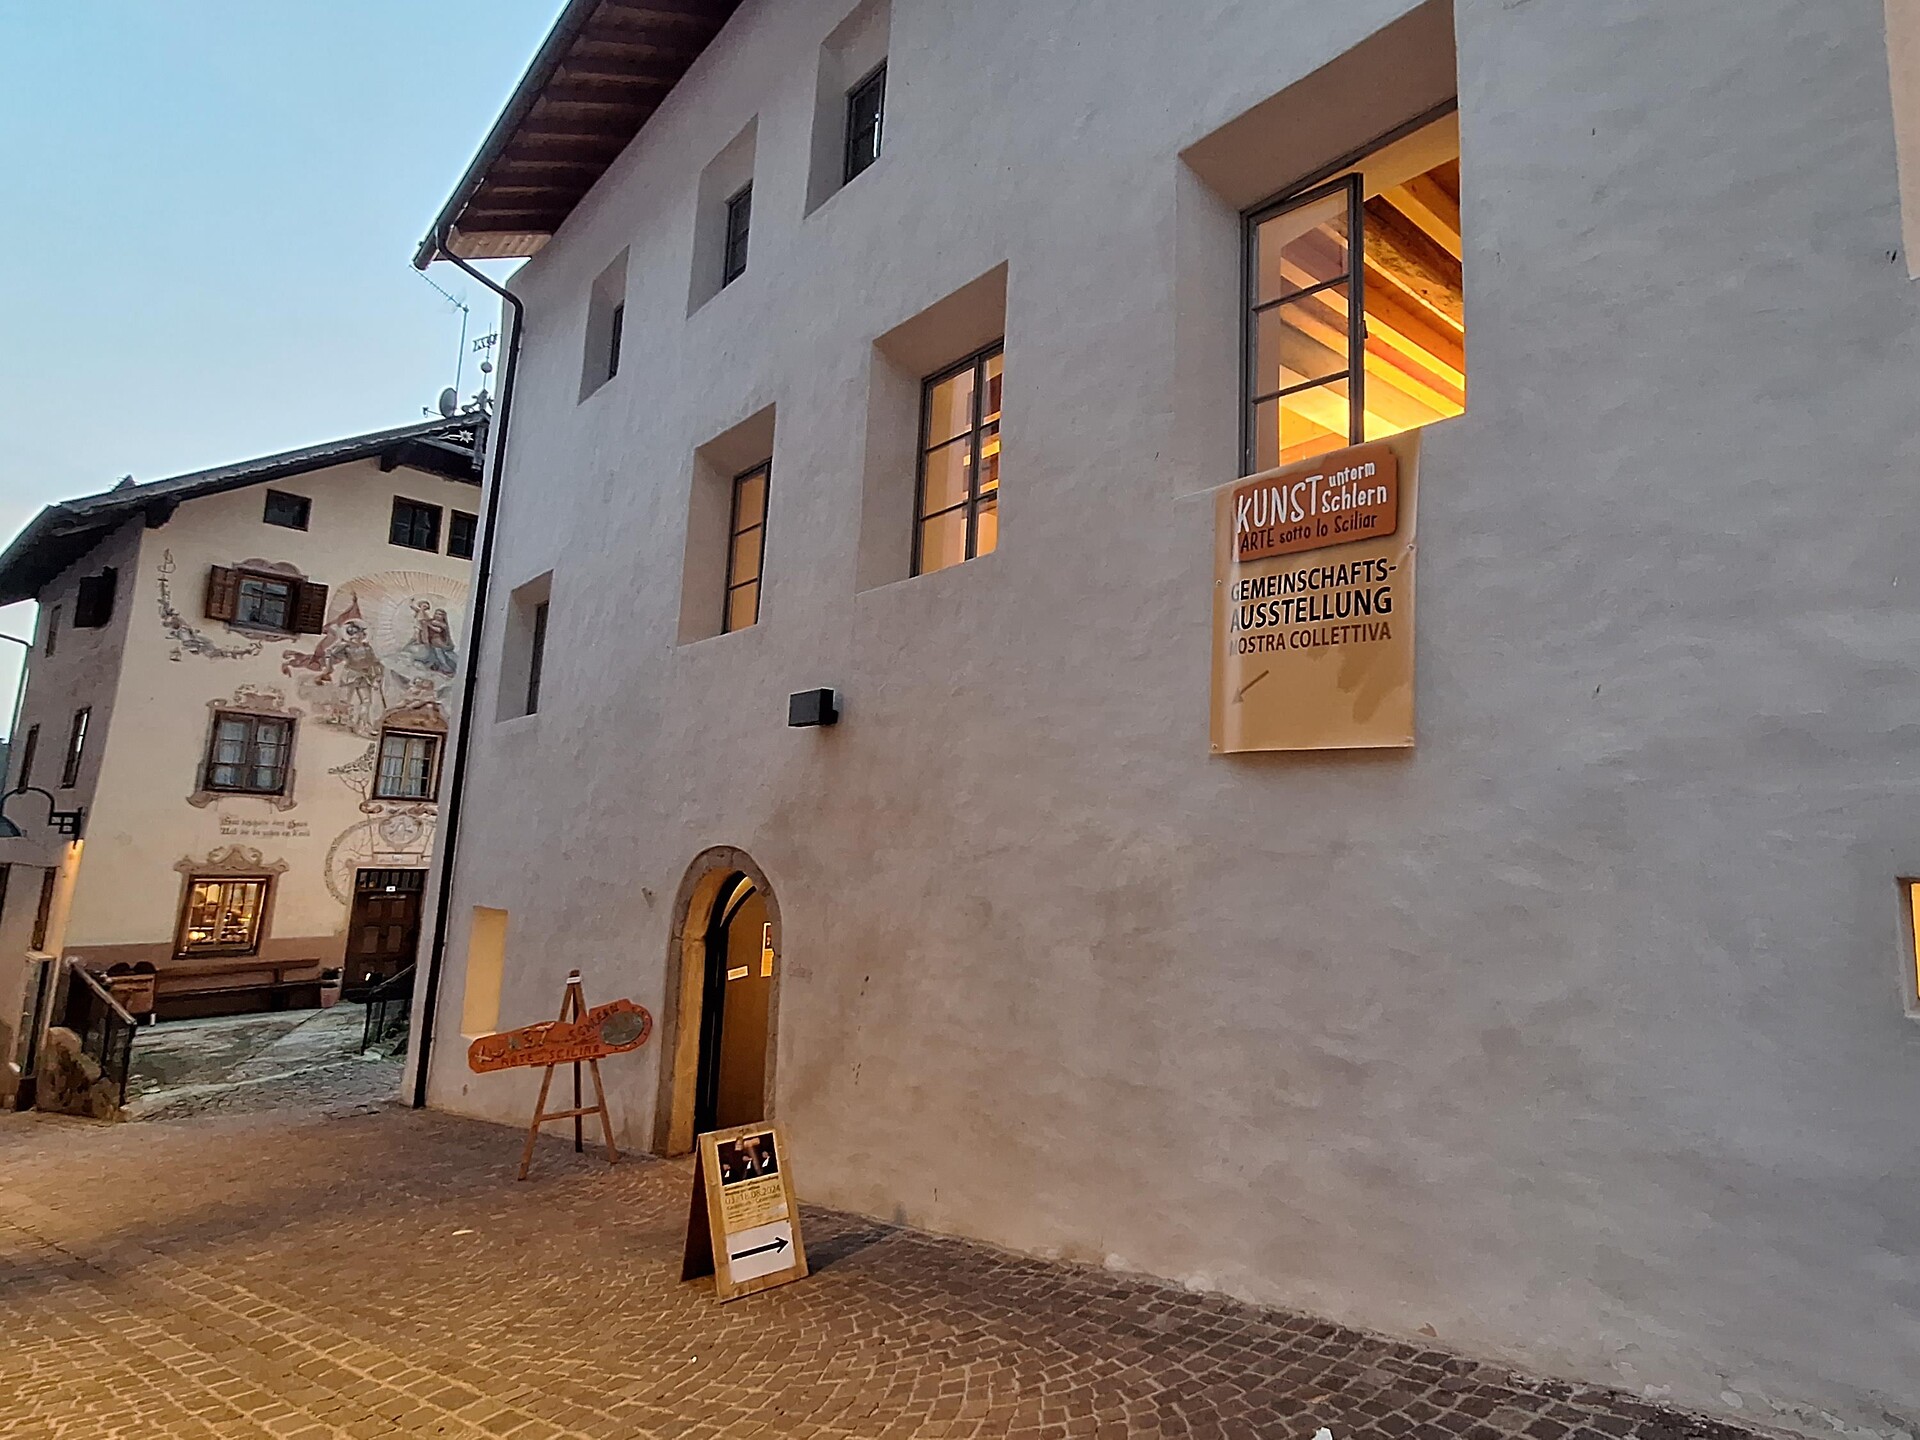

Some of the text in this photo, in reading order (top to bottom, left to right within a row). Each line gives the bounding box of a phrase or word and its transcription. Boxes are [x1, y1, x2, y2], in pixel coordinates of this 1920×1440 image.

[1329, 462, 1375, 488] unterm
[1237, 475, 1323, 534] KUNST
[1321, 482, 1387, 514] Schlern
[1240, 511, 1378, 554] ARTE sotto lo Sciliar
[1231, 558, 1397, 602] GEMEINSCHAFTS-
[1230, 586, 1392, 633] AUSSTELLUNG
[1289, 621, 1392, 649] COLLETTIVA
